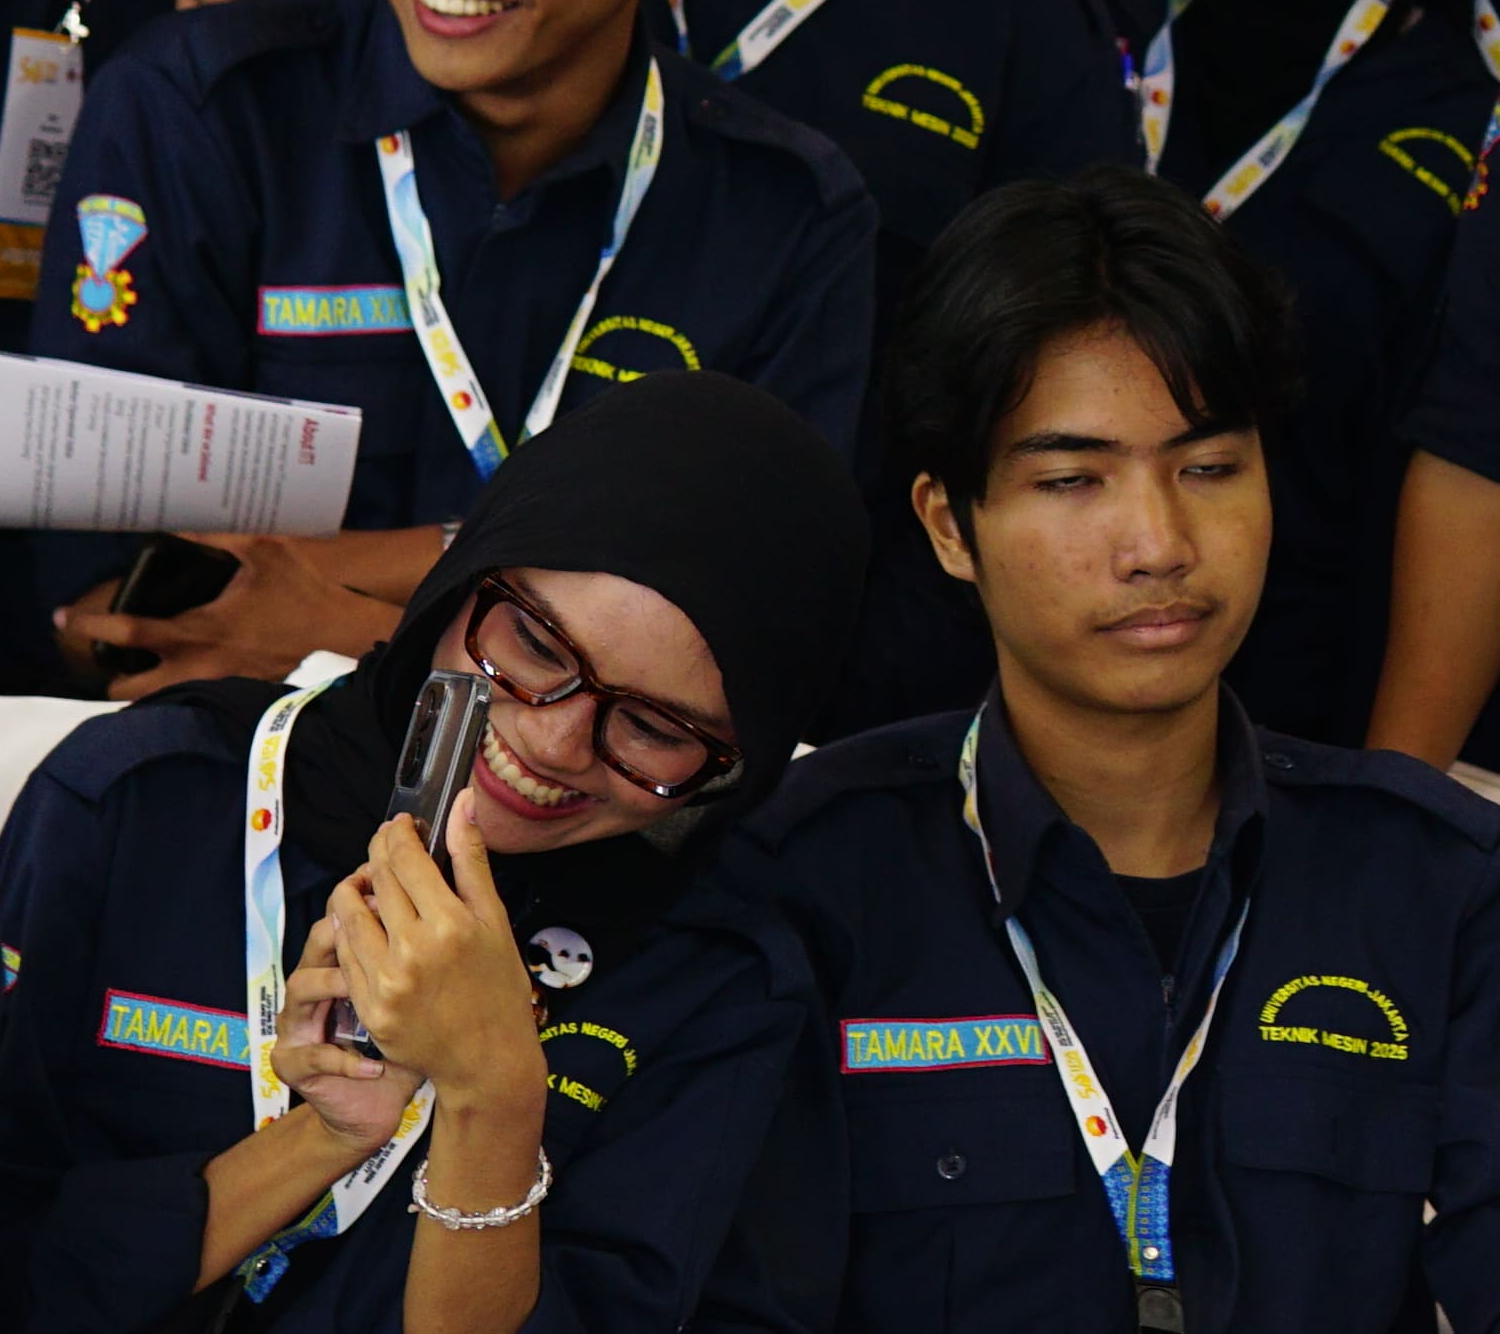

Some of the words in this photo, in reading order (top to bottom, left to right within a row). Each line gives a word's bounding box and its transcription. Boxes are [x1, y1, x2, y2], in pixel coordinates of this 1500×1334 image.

[265, 295, 362, 328] TAMARA
[1258, 975, 1320, 1025] UNIVERSITAS
[1320, 975, 1370, 994] NEGERI
[1365, 989, 1410, 1042] JAKARTA
[110, 1003, 231, 1059] TAMARA
[580, 1021, 629, 1052] NEGERI
[848, 1027, 966, 1064] TAMARA
[972, 1024, 1045, 1057] XXVI
[1258, 1025, 1320, 1044] TEKNIK
[1321, 1030, 1369, 1056] MESIN
[1369, 1041, 1409, 1061] 2025
